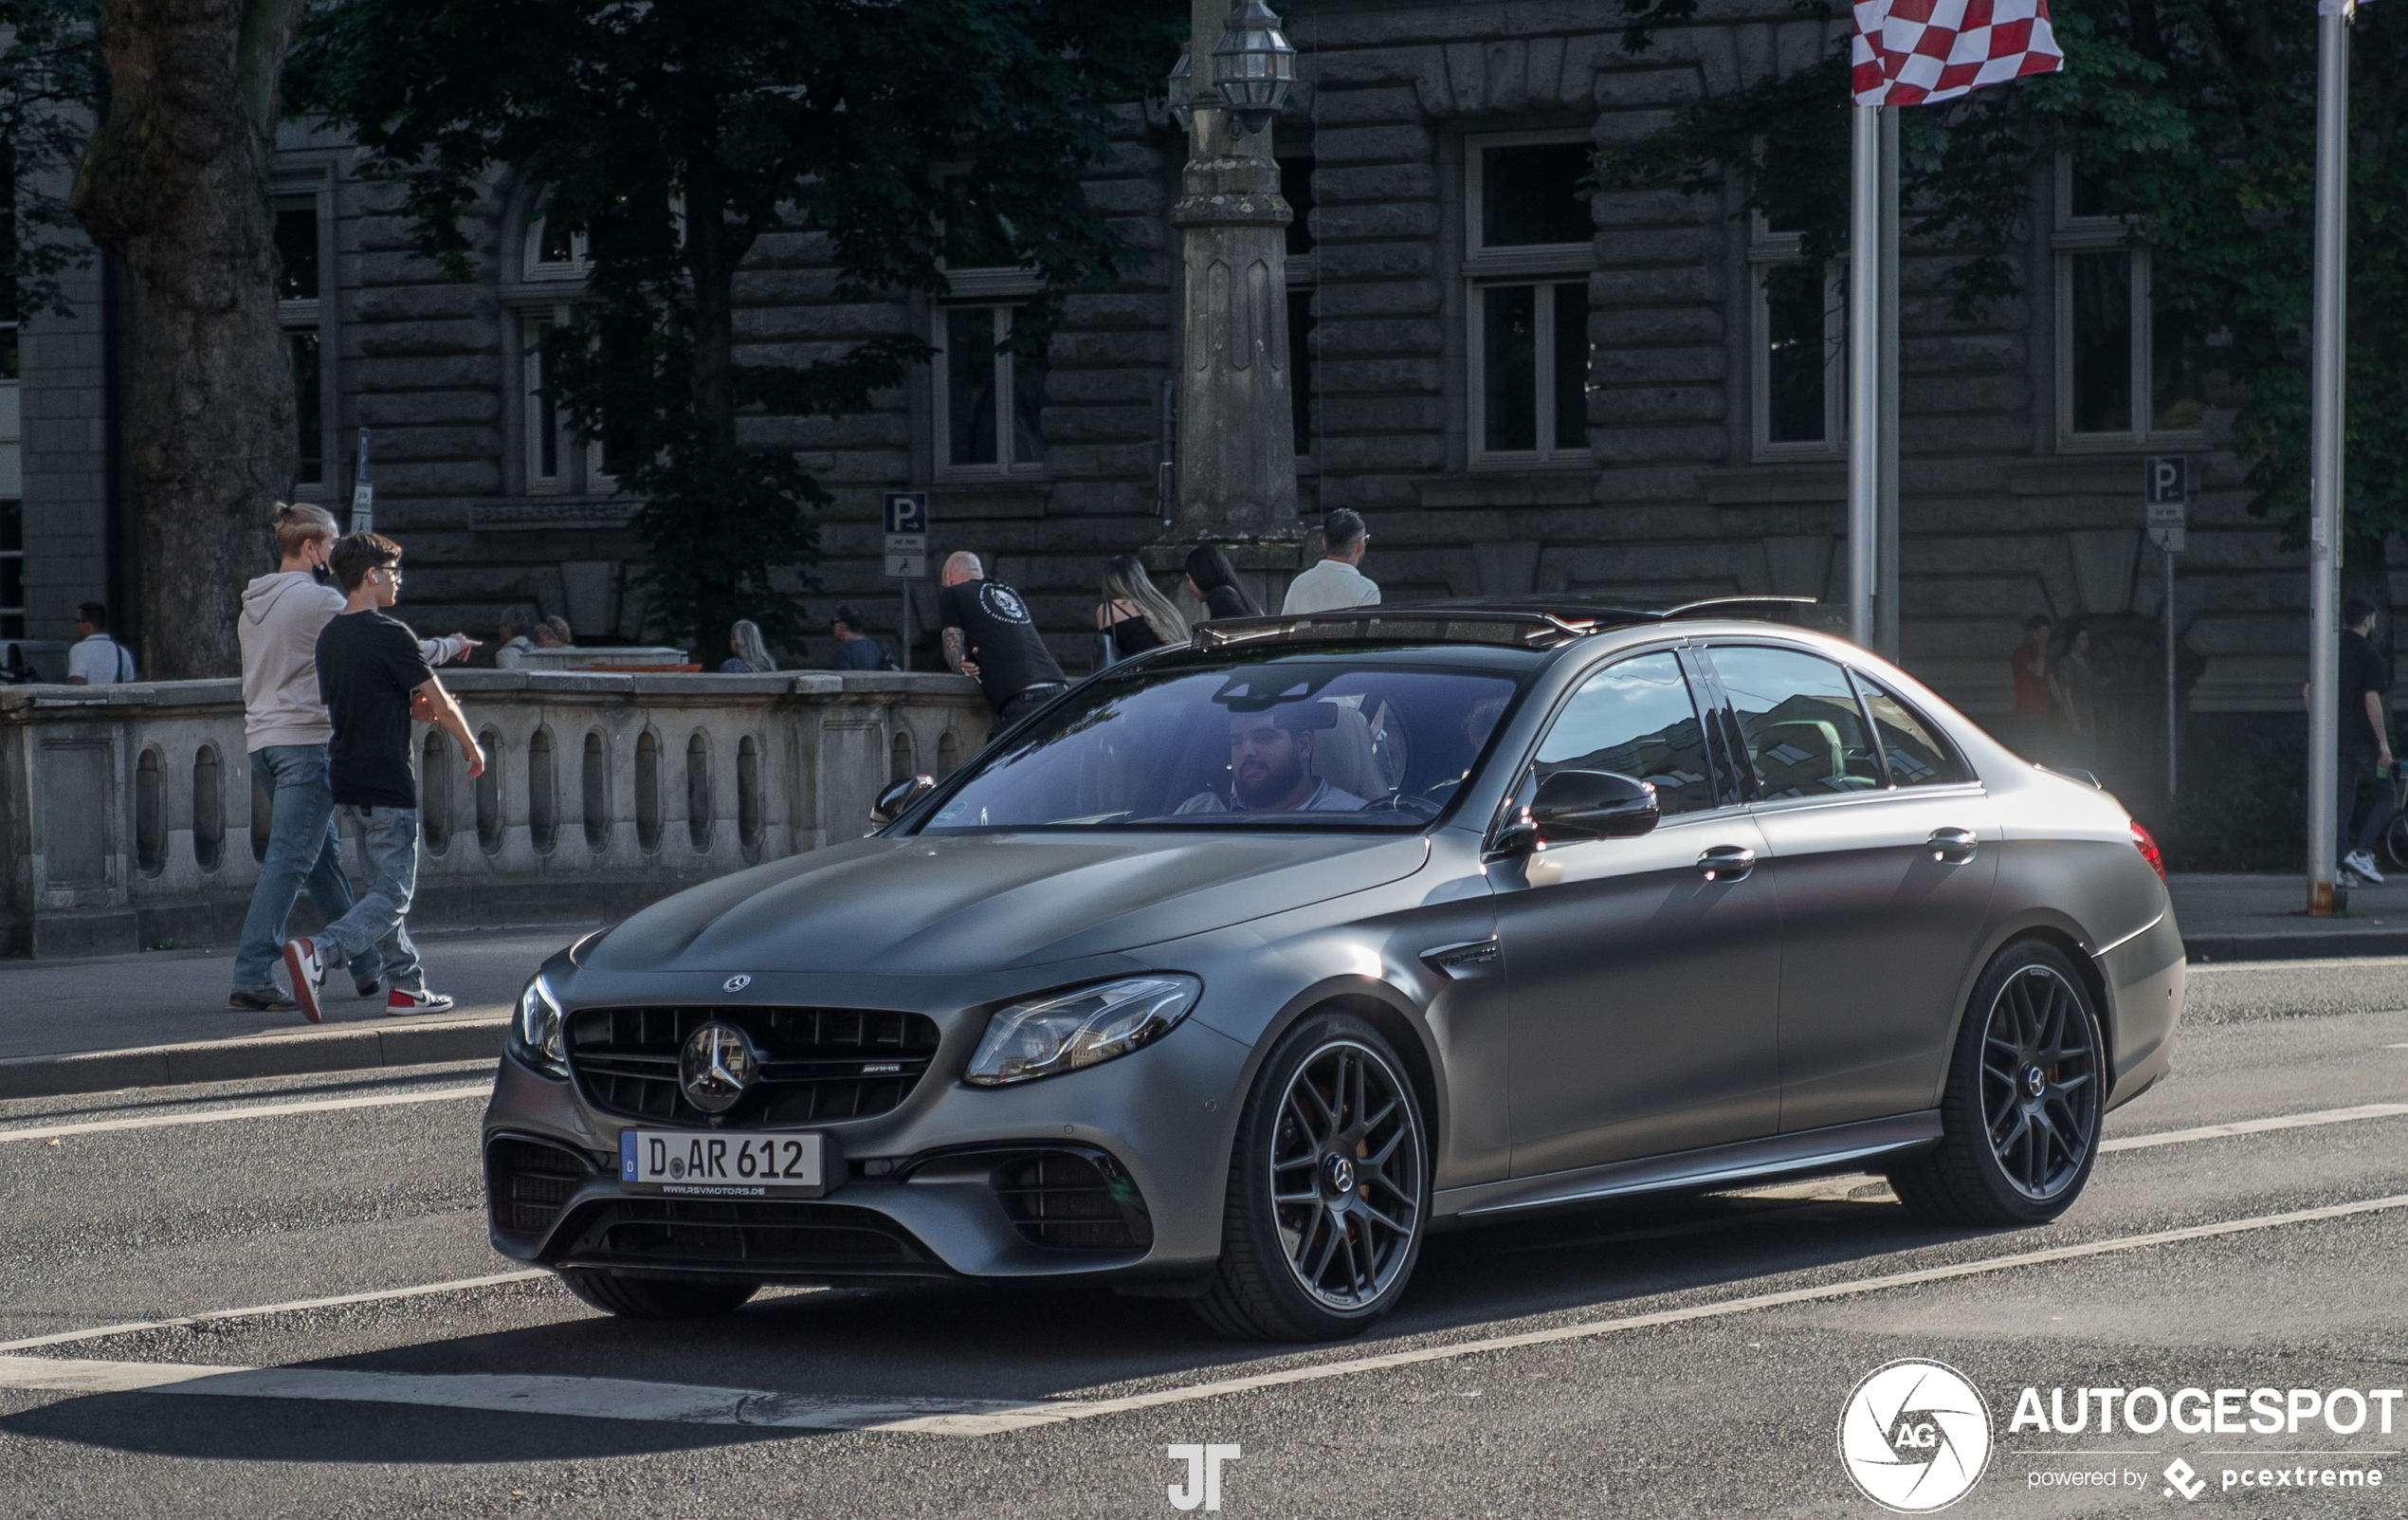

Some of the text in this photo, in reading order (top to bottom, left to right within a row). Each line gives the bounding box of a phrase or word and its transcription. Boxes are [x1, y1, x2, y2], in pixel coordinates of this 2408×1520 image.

[2156, 463, 2177, 501] P
[893, 498, 917, 532] P
[627, 1161, 633, 1173] D
[648, 1139, 804, 1179] D AR 612
[663, 1185, 765, 1196] WWW.RSVMOTORS.DE
